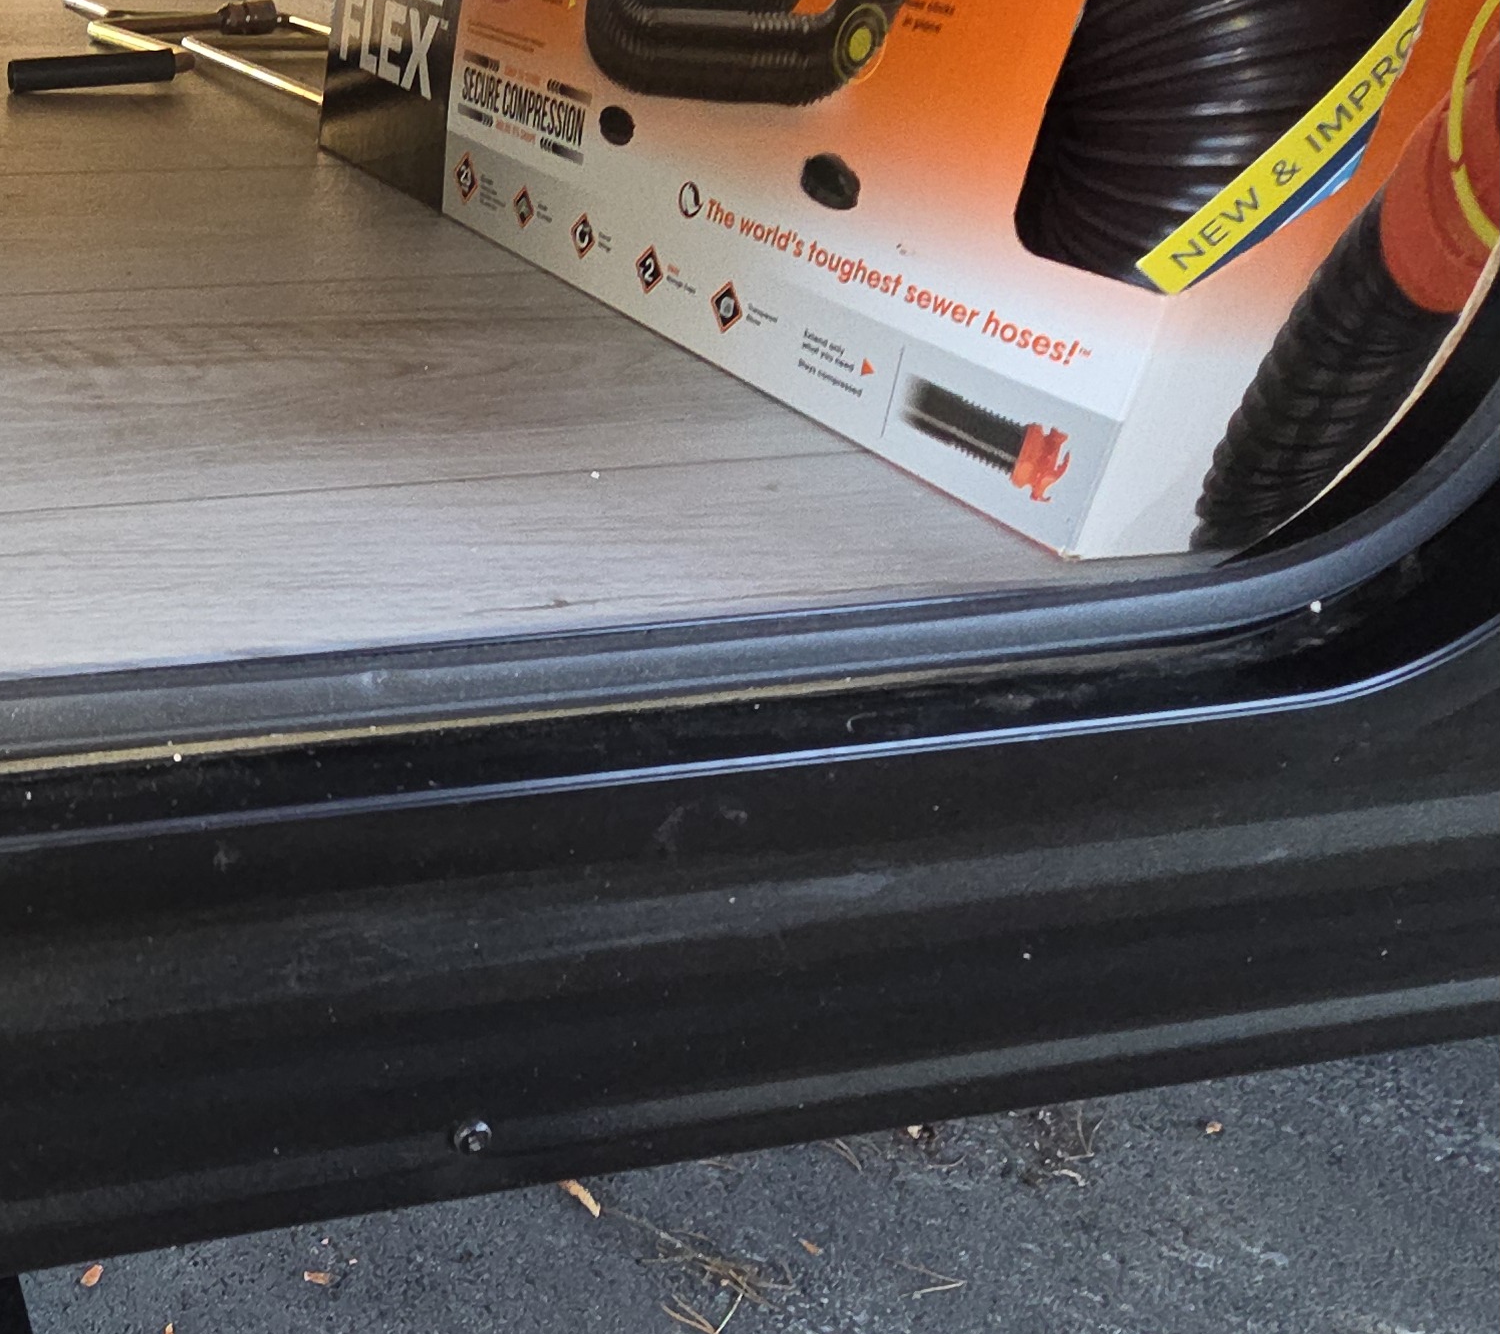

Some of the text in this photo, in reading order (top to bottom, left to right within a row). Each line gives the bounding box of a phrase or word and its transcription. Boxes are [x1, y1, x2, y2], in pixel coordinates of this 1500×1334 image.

[462, 66, 502, 113] SECURE
[502, 81, 586, 147] COMPRESSION
[706, 198, 736, 230] The
[740, 216, 804, 258] world's
[808, 240, 904, 296] toughest
[905, 283, 982, 329] sewer
[1170, 186, 1259, 270] NEW
[1271, 159, 1303, 187] &
